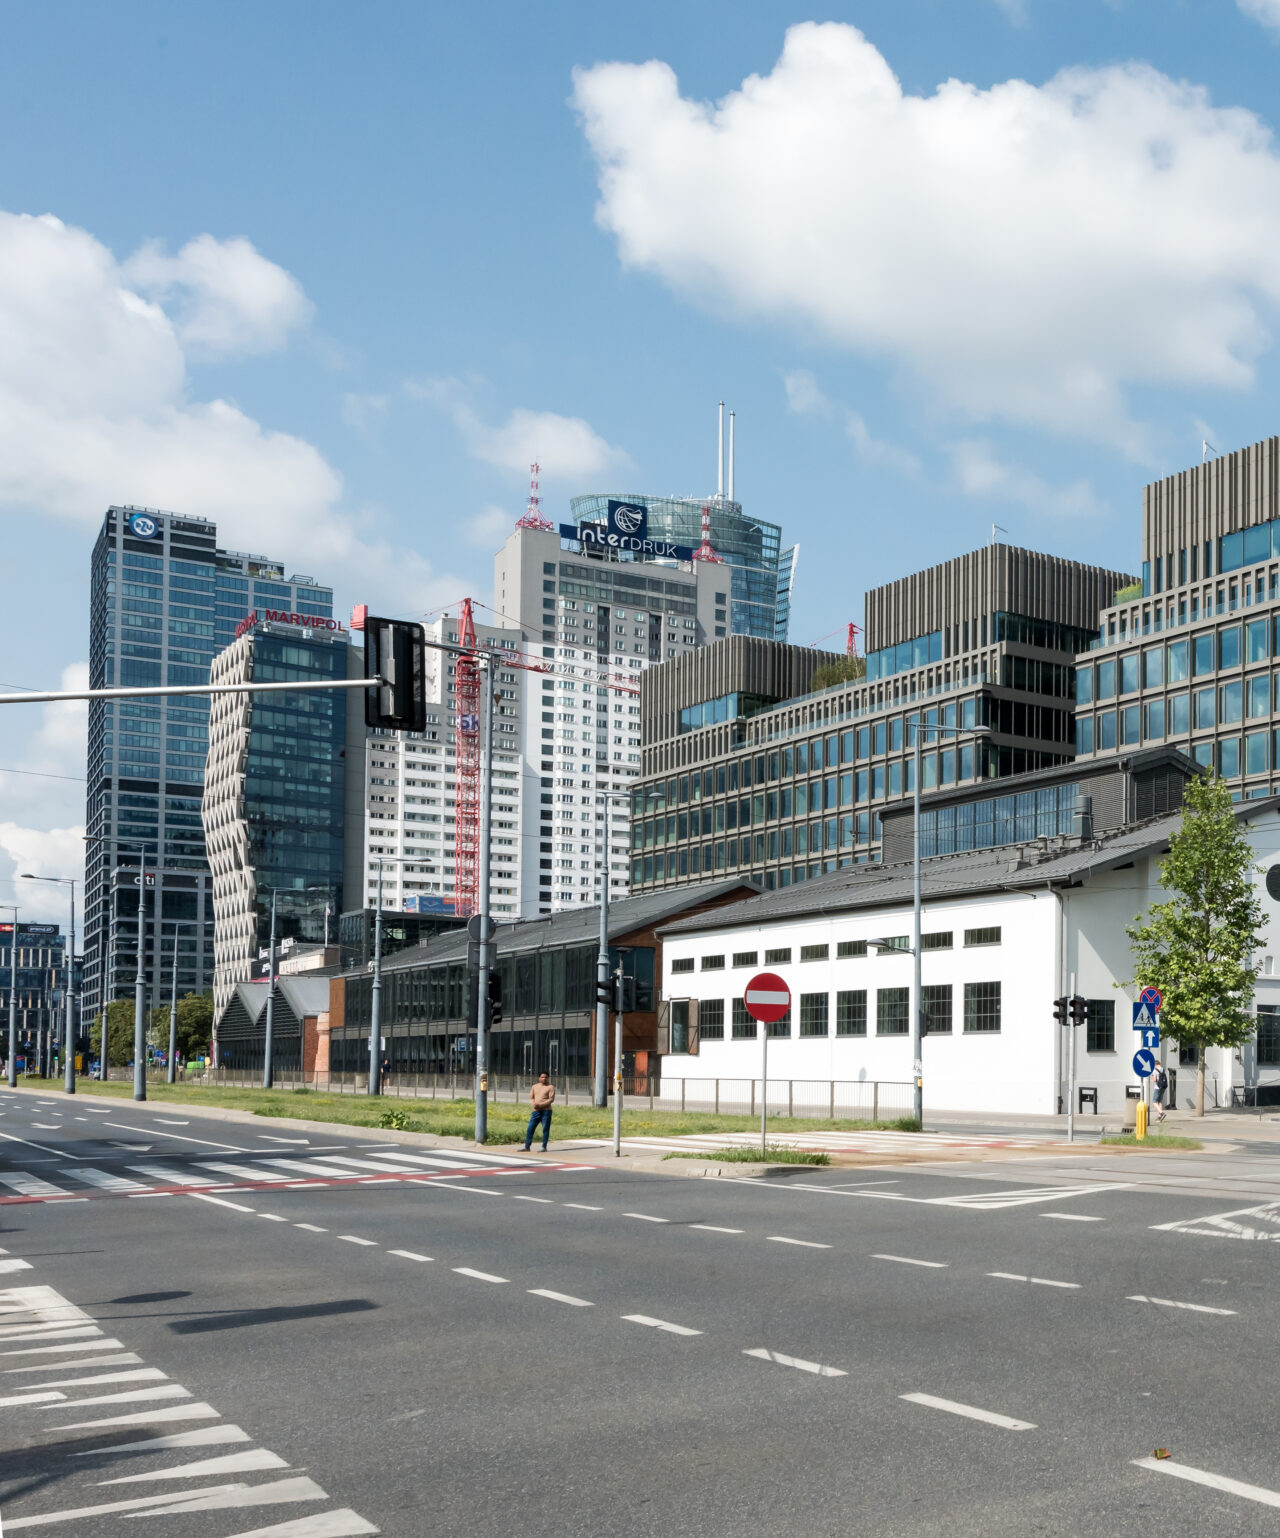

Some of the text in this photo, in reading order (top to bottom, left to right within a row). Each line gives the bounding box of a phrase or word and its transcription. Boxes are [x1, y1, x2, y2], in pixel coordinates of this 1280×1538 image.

[135, 520, 153, 533] PZU
[576, 525, 677, 558] interDRUK
[265, 609, 347, 632] MARVIPOL
[134, 873, 155, 885] cti
